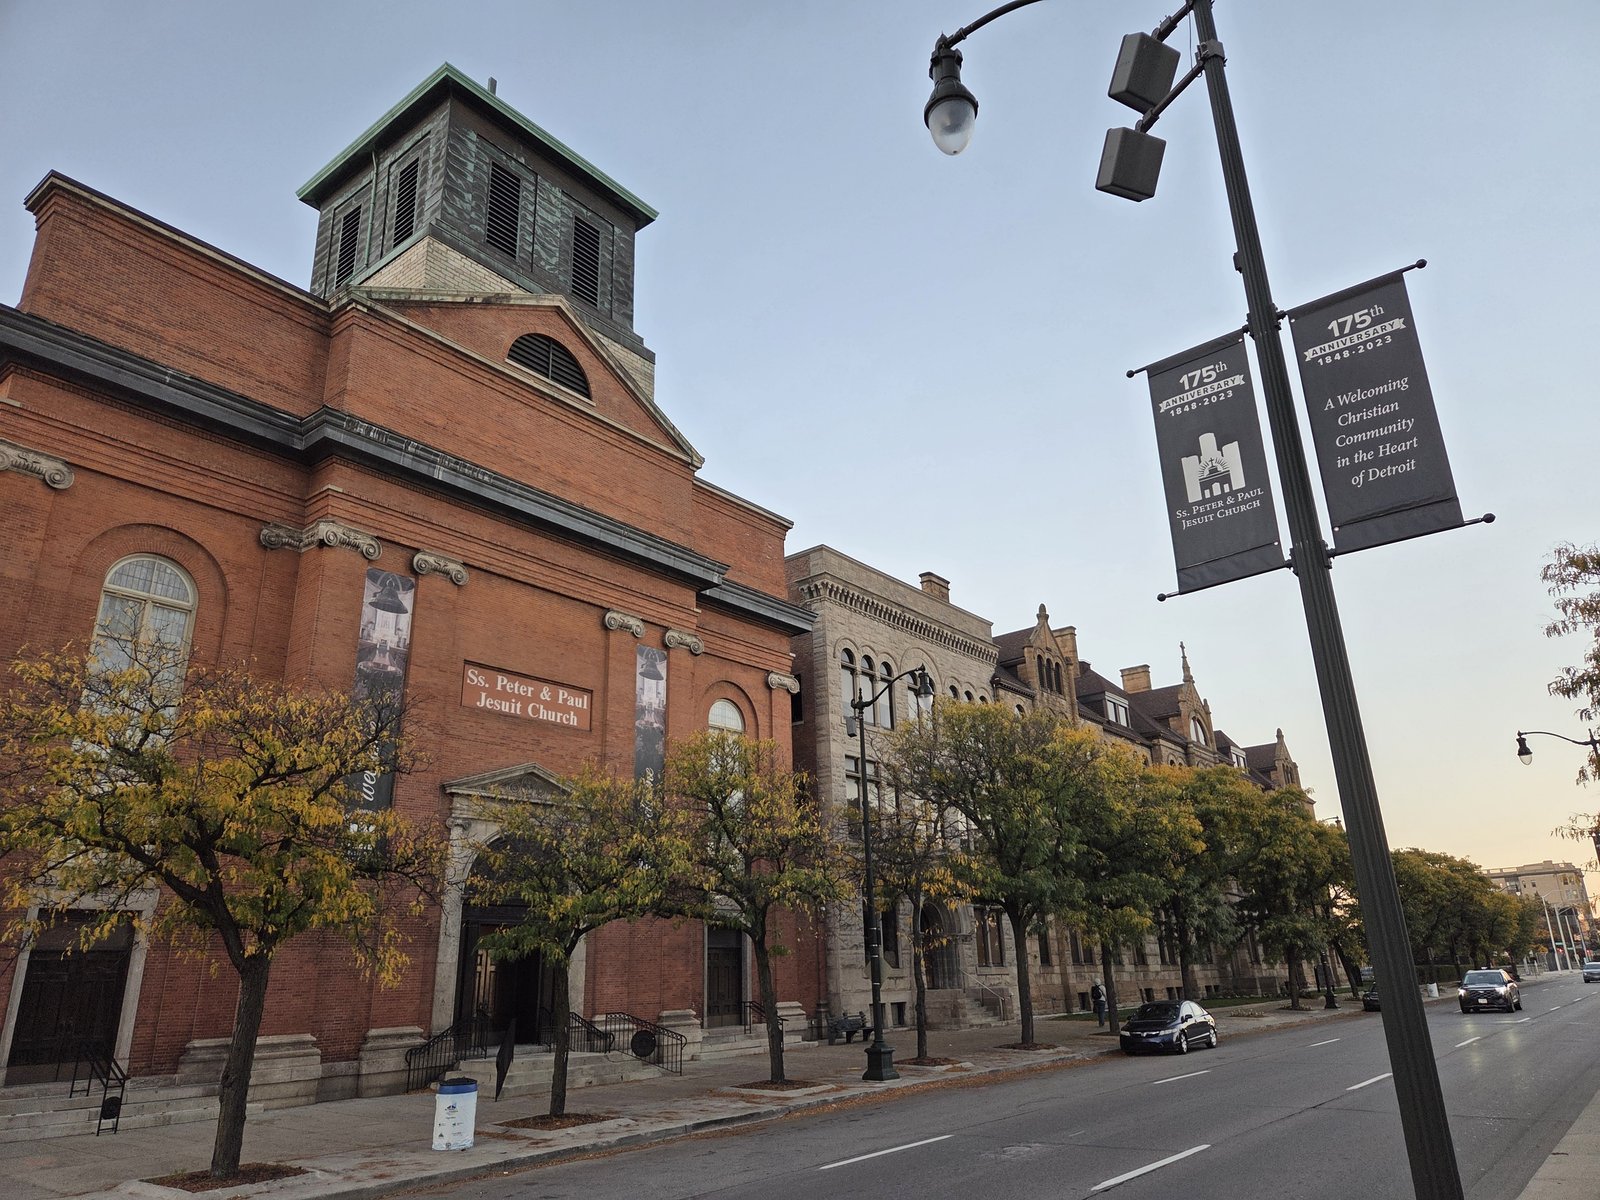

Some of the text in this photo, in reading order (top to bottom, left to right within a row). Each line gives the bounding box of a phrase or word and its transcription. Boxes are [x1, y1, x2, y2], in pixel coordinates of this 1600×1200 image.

[1328, 304, 1384, 337] 175th
[1311, 321, 1395, 356] ANNIVERSARY
[1179, 361, 1227, 390] 175th
[1165, 378, 1236, 408] ANNIVERSARY
[1324, 377, 1409, 411] A Welcoming
[1338, 402, 1400, 426] Christian
[1335, 418, 1414, 447] Community
[1337, 436, 1418, 468] in the Heart
[1351, 459, 1416, 487] of Detroit
[1182, 500, 1260, 530] JESUIT CHURCH
[1192, 500, 1224, 514] PETER
[1226, 496, 1235, 505] &
[1237, 488, 1264, 501] PAUL
[467, 669, 588, 709] Ss. Peter & Paul
[476, 692, 578, 726] Jesuit Church
